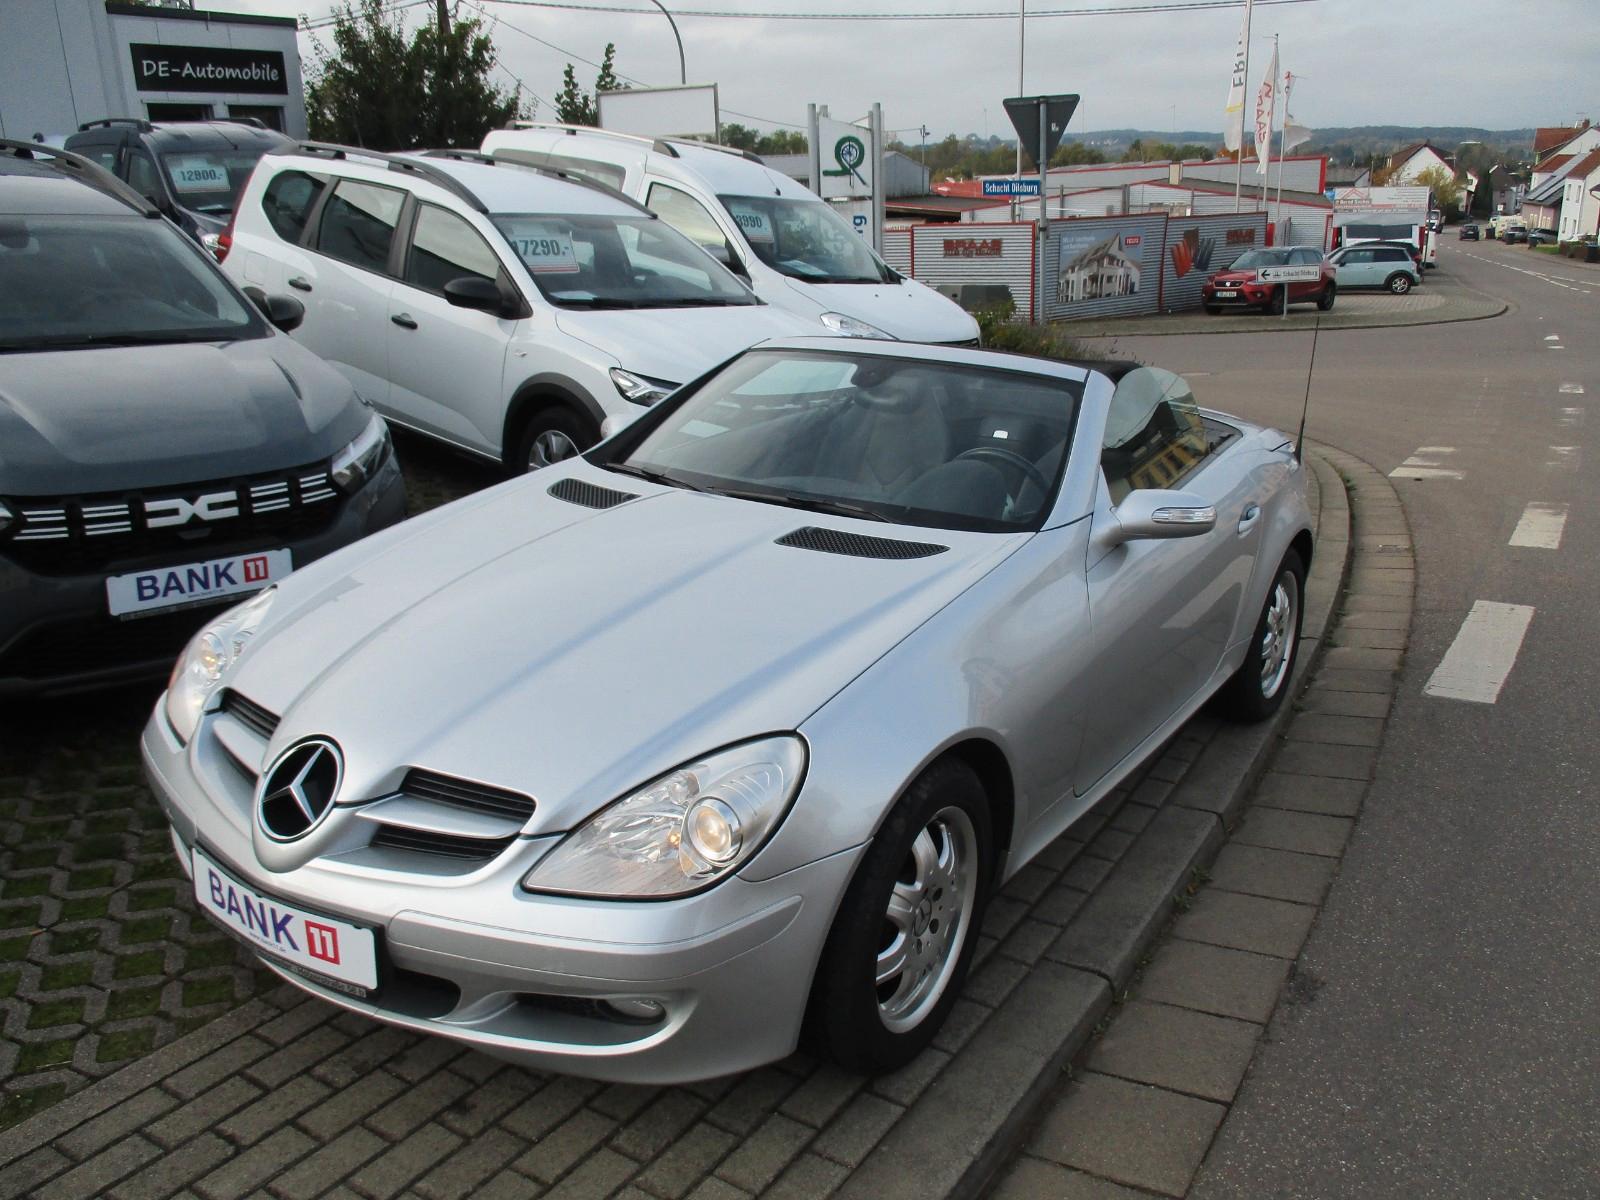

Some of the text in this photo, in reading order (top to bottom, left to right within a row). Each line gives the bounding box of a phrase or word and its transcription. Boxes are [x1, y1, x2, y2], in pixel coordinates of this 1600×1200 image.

[141, 60, 280, 81] DE-Automobile
[985, 182, 1038, 195] Schacht Dilsburg
[136, 558, 266, 601] BANK 11
[208, 867, 337, 961] BANK 11
